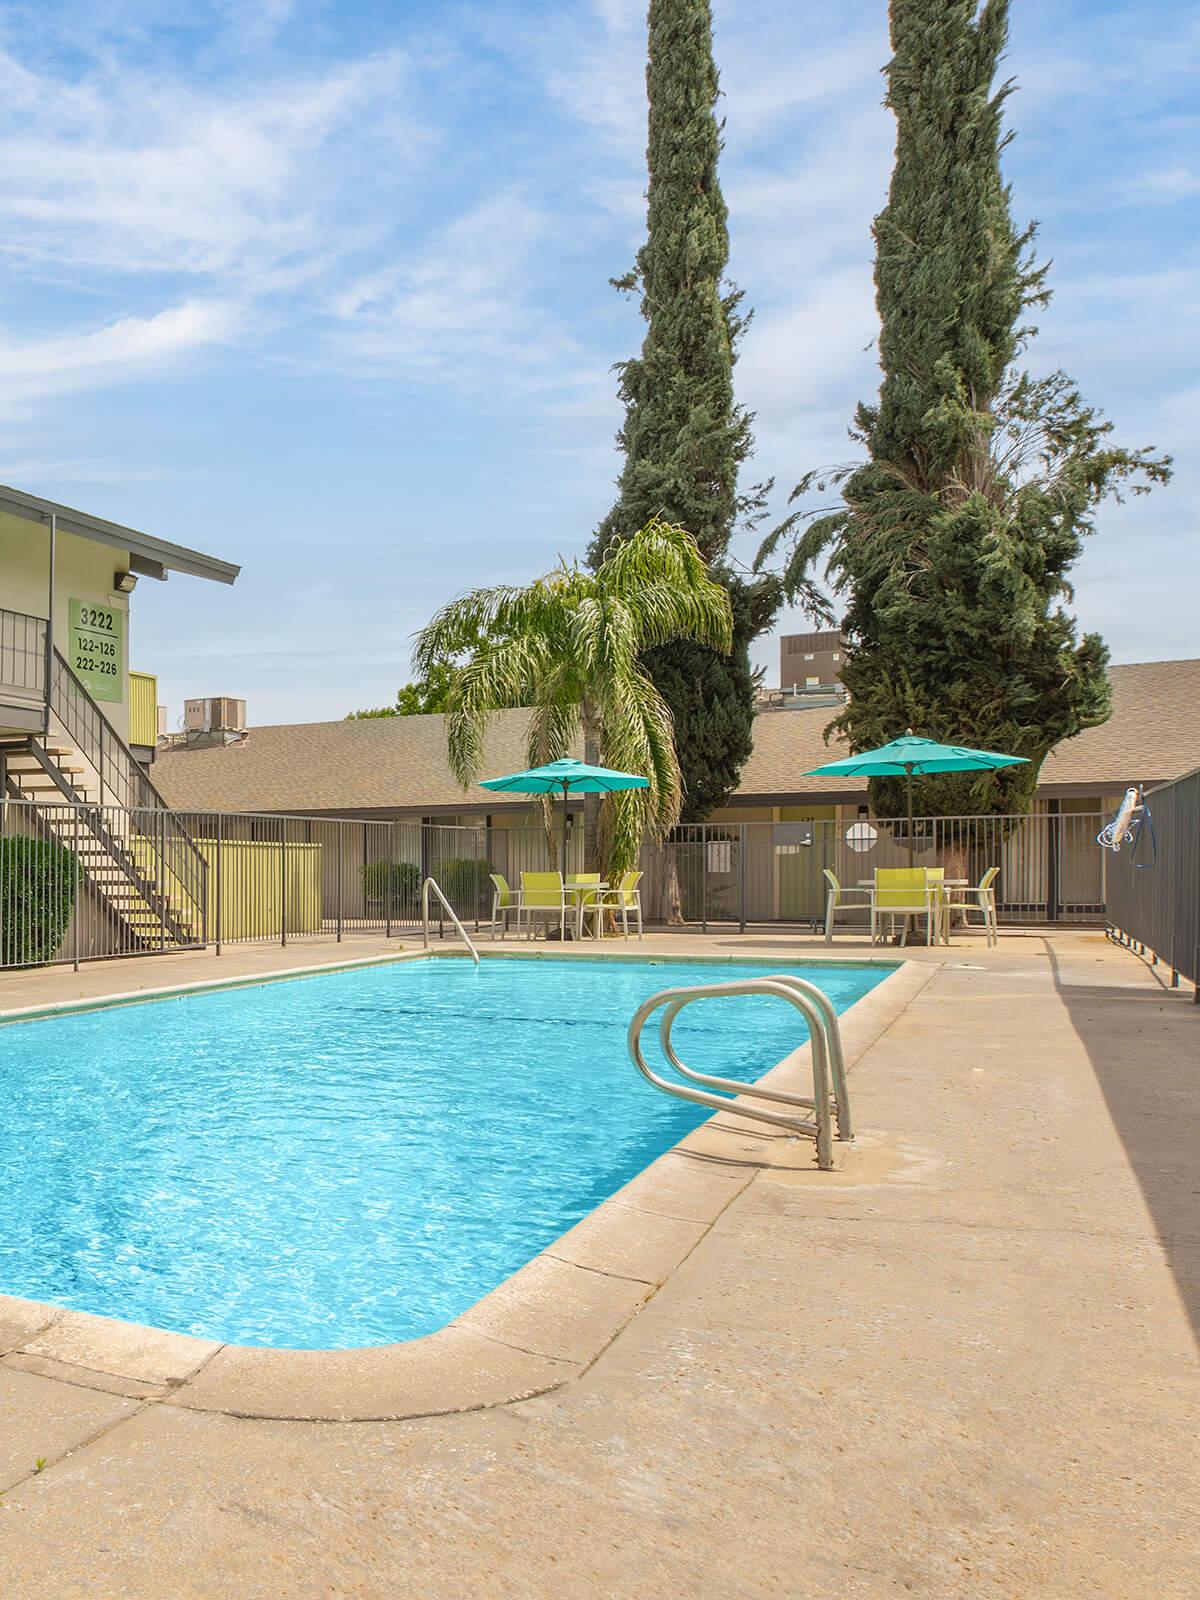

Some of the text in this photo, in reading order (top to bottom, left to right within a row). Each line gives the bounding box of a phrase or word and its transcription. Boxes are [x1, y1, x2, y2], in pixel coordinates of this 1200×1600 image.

[81, 608, 113, 631] 3222
[78, 637, 115, 656] 122-126
[76, 656, 117, 676] 222-226
